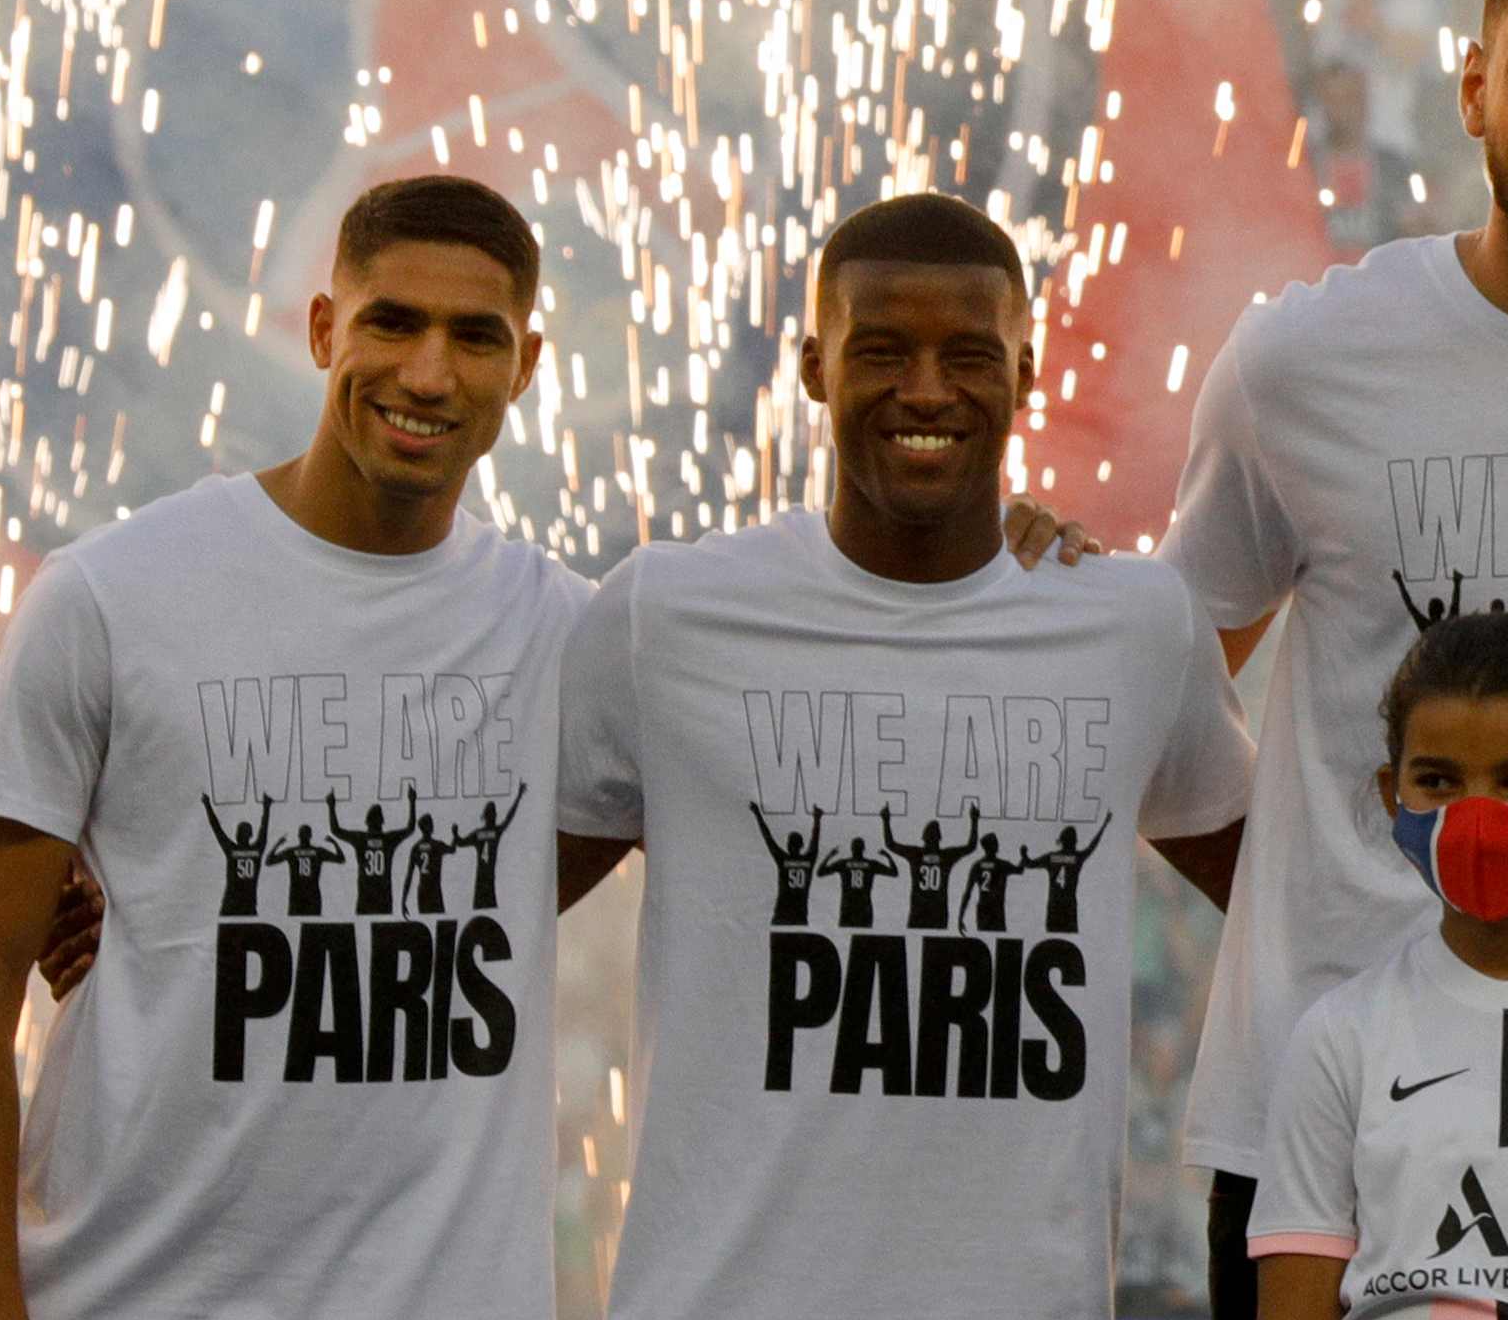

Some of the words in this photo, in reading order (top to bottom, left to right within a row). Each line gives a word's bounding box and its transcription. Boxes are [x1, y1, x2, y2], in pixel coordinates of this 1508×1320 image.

[197, 674, 351, 805] WE
[378, 673, 515, 801] ARE
[744, 690, 907, 816] WE
[937, 695, 1110, 823] ARE
[364, 850, 385, 876] 30
[420, 853, 430, 874] 2
[481, 840, 489, 864] 4
[236, 859, 255, 879] 50
[298, 857, 311, 877] 18
[788, 869, 806, 889] 50
[850, 869, 864, 889] 18
[919, 864, 942, 891] 30
[1056, 865, 1067, 889] 4
[981, 870, 991, 891] 2
[213, 915, 517, 1083] PARIS
[764, 931, 1087, 1101] PARIS
[1363, 1268, 1449, 1297] ACCOR
